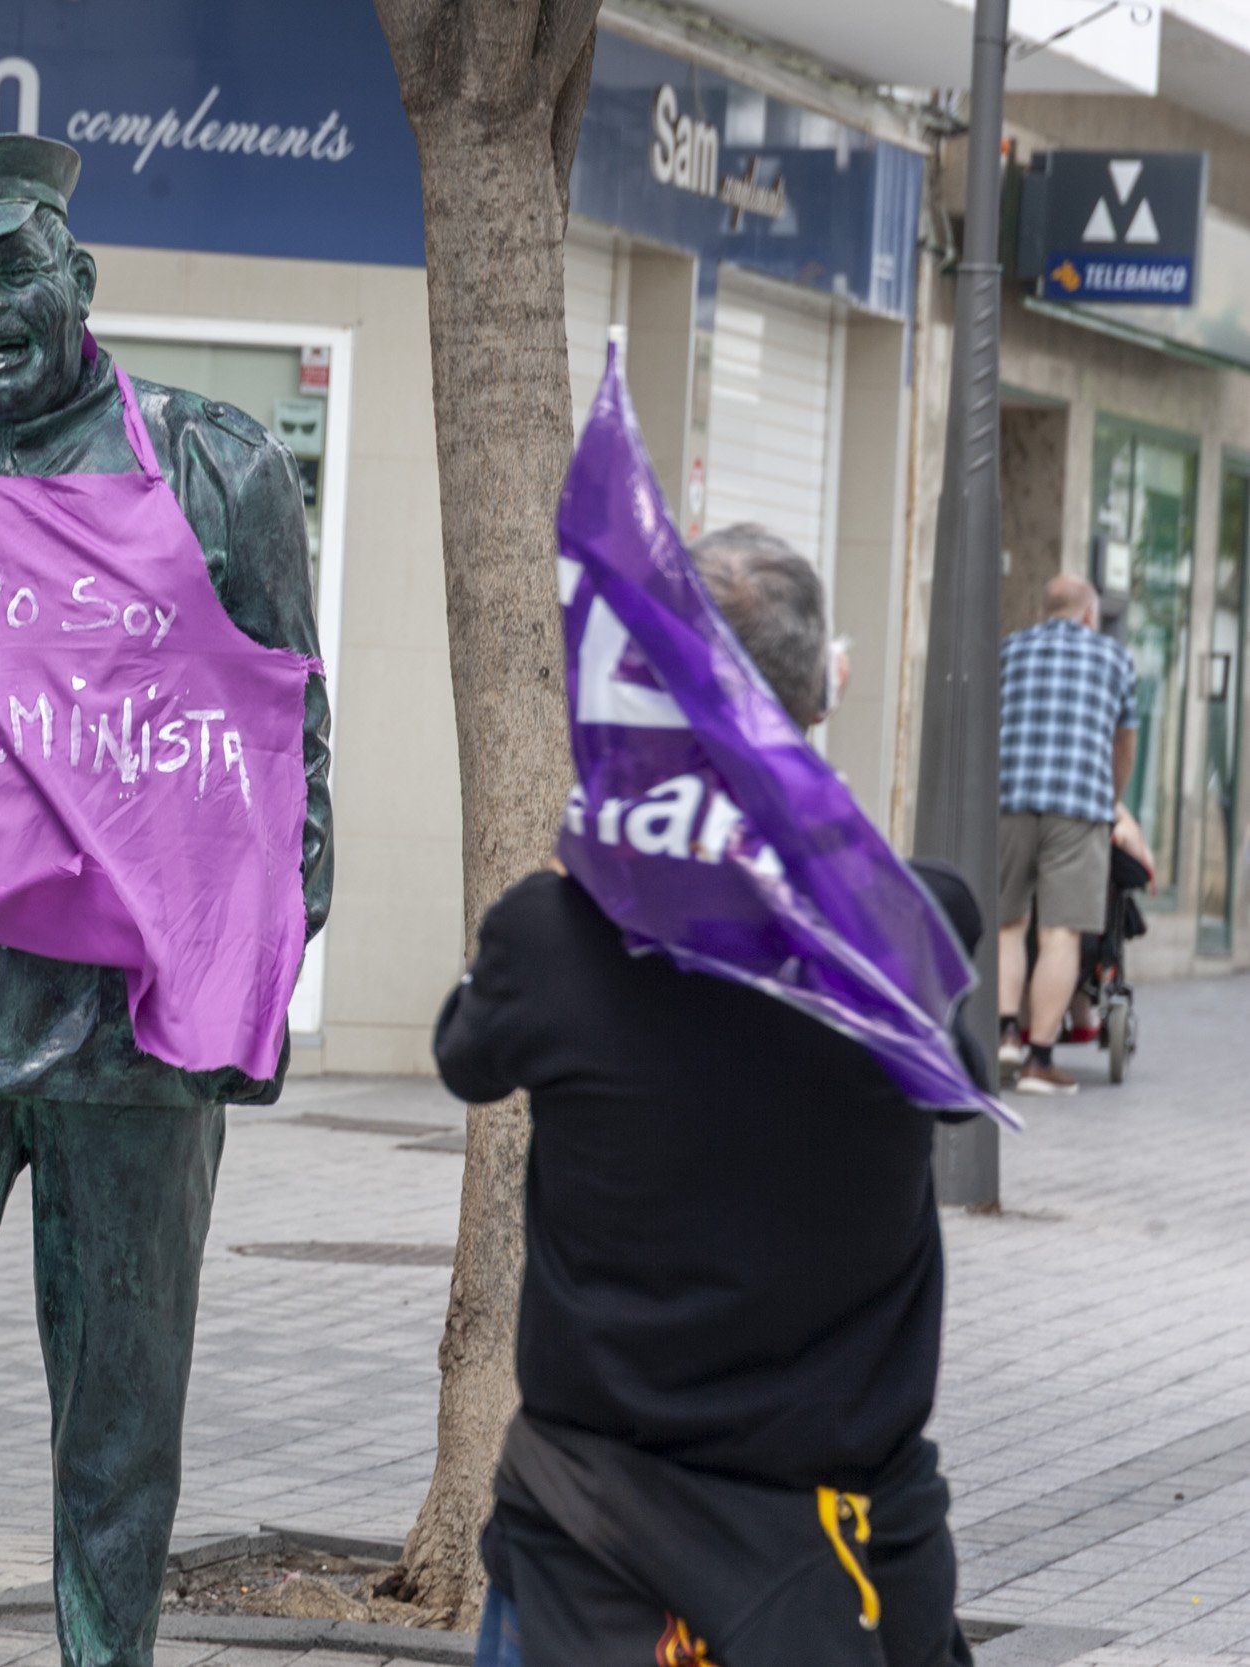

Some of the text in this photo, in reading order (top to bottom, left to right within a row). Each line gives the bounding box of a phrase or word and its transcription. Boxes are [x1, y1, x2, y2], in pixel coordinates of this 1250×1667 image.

[66, 86, 355, 174] complements
[652, 84, 719, 197] Sam
[1084, 262, 1188, 293] TELEBANCO
